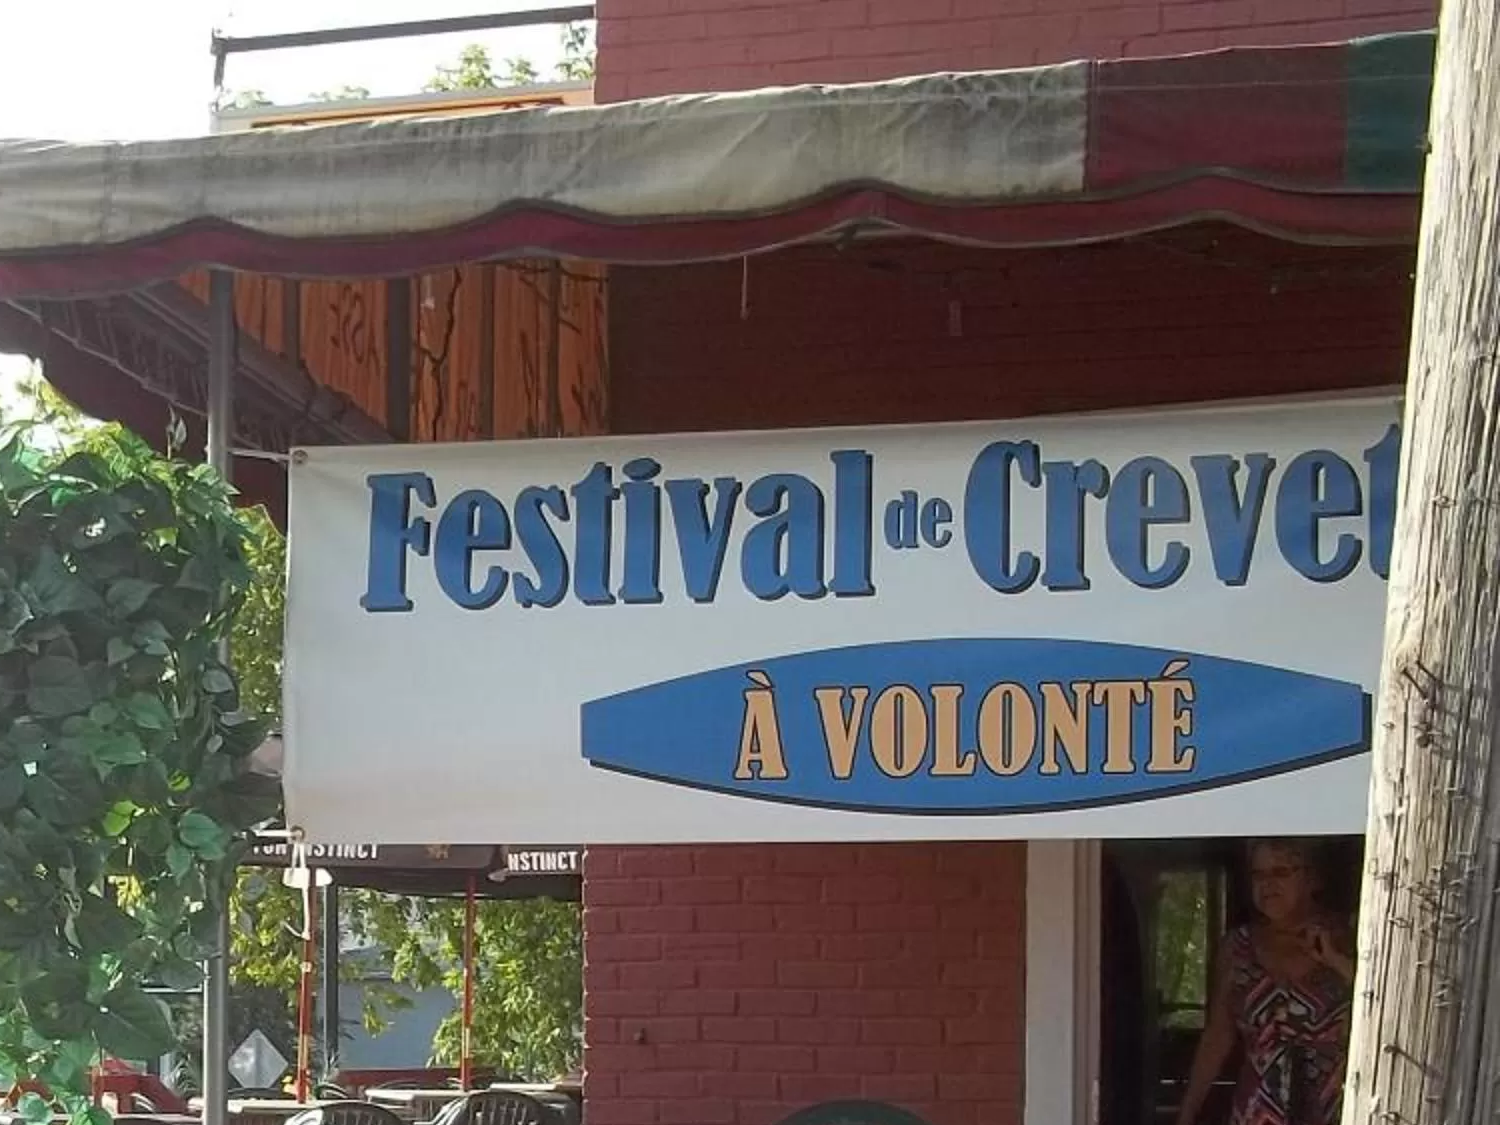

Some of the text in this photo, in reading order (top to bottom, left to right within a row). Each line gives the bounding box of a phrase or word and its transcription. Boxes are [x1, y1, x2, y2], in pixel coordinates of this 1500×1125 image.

[361, 449, 876, 612] Festival
[883, 490, 953, 549] de
[733, 659, 1195, 780] À VOLONTÉ
[508, 850, 579, 872] NSTINCT
